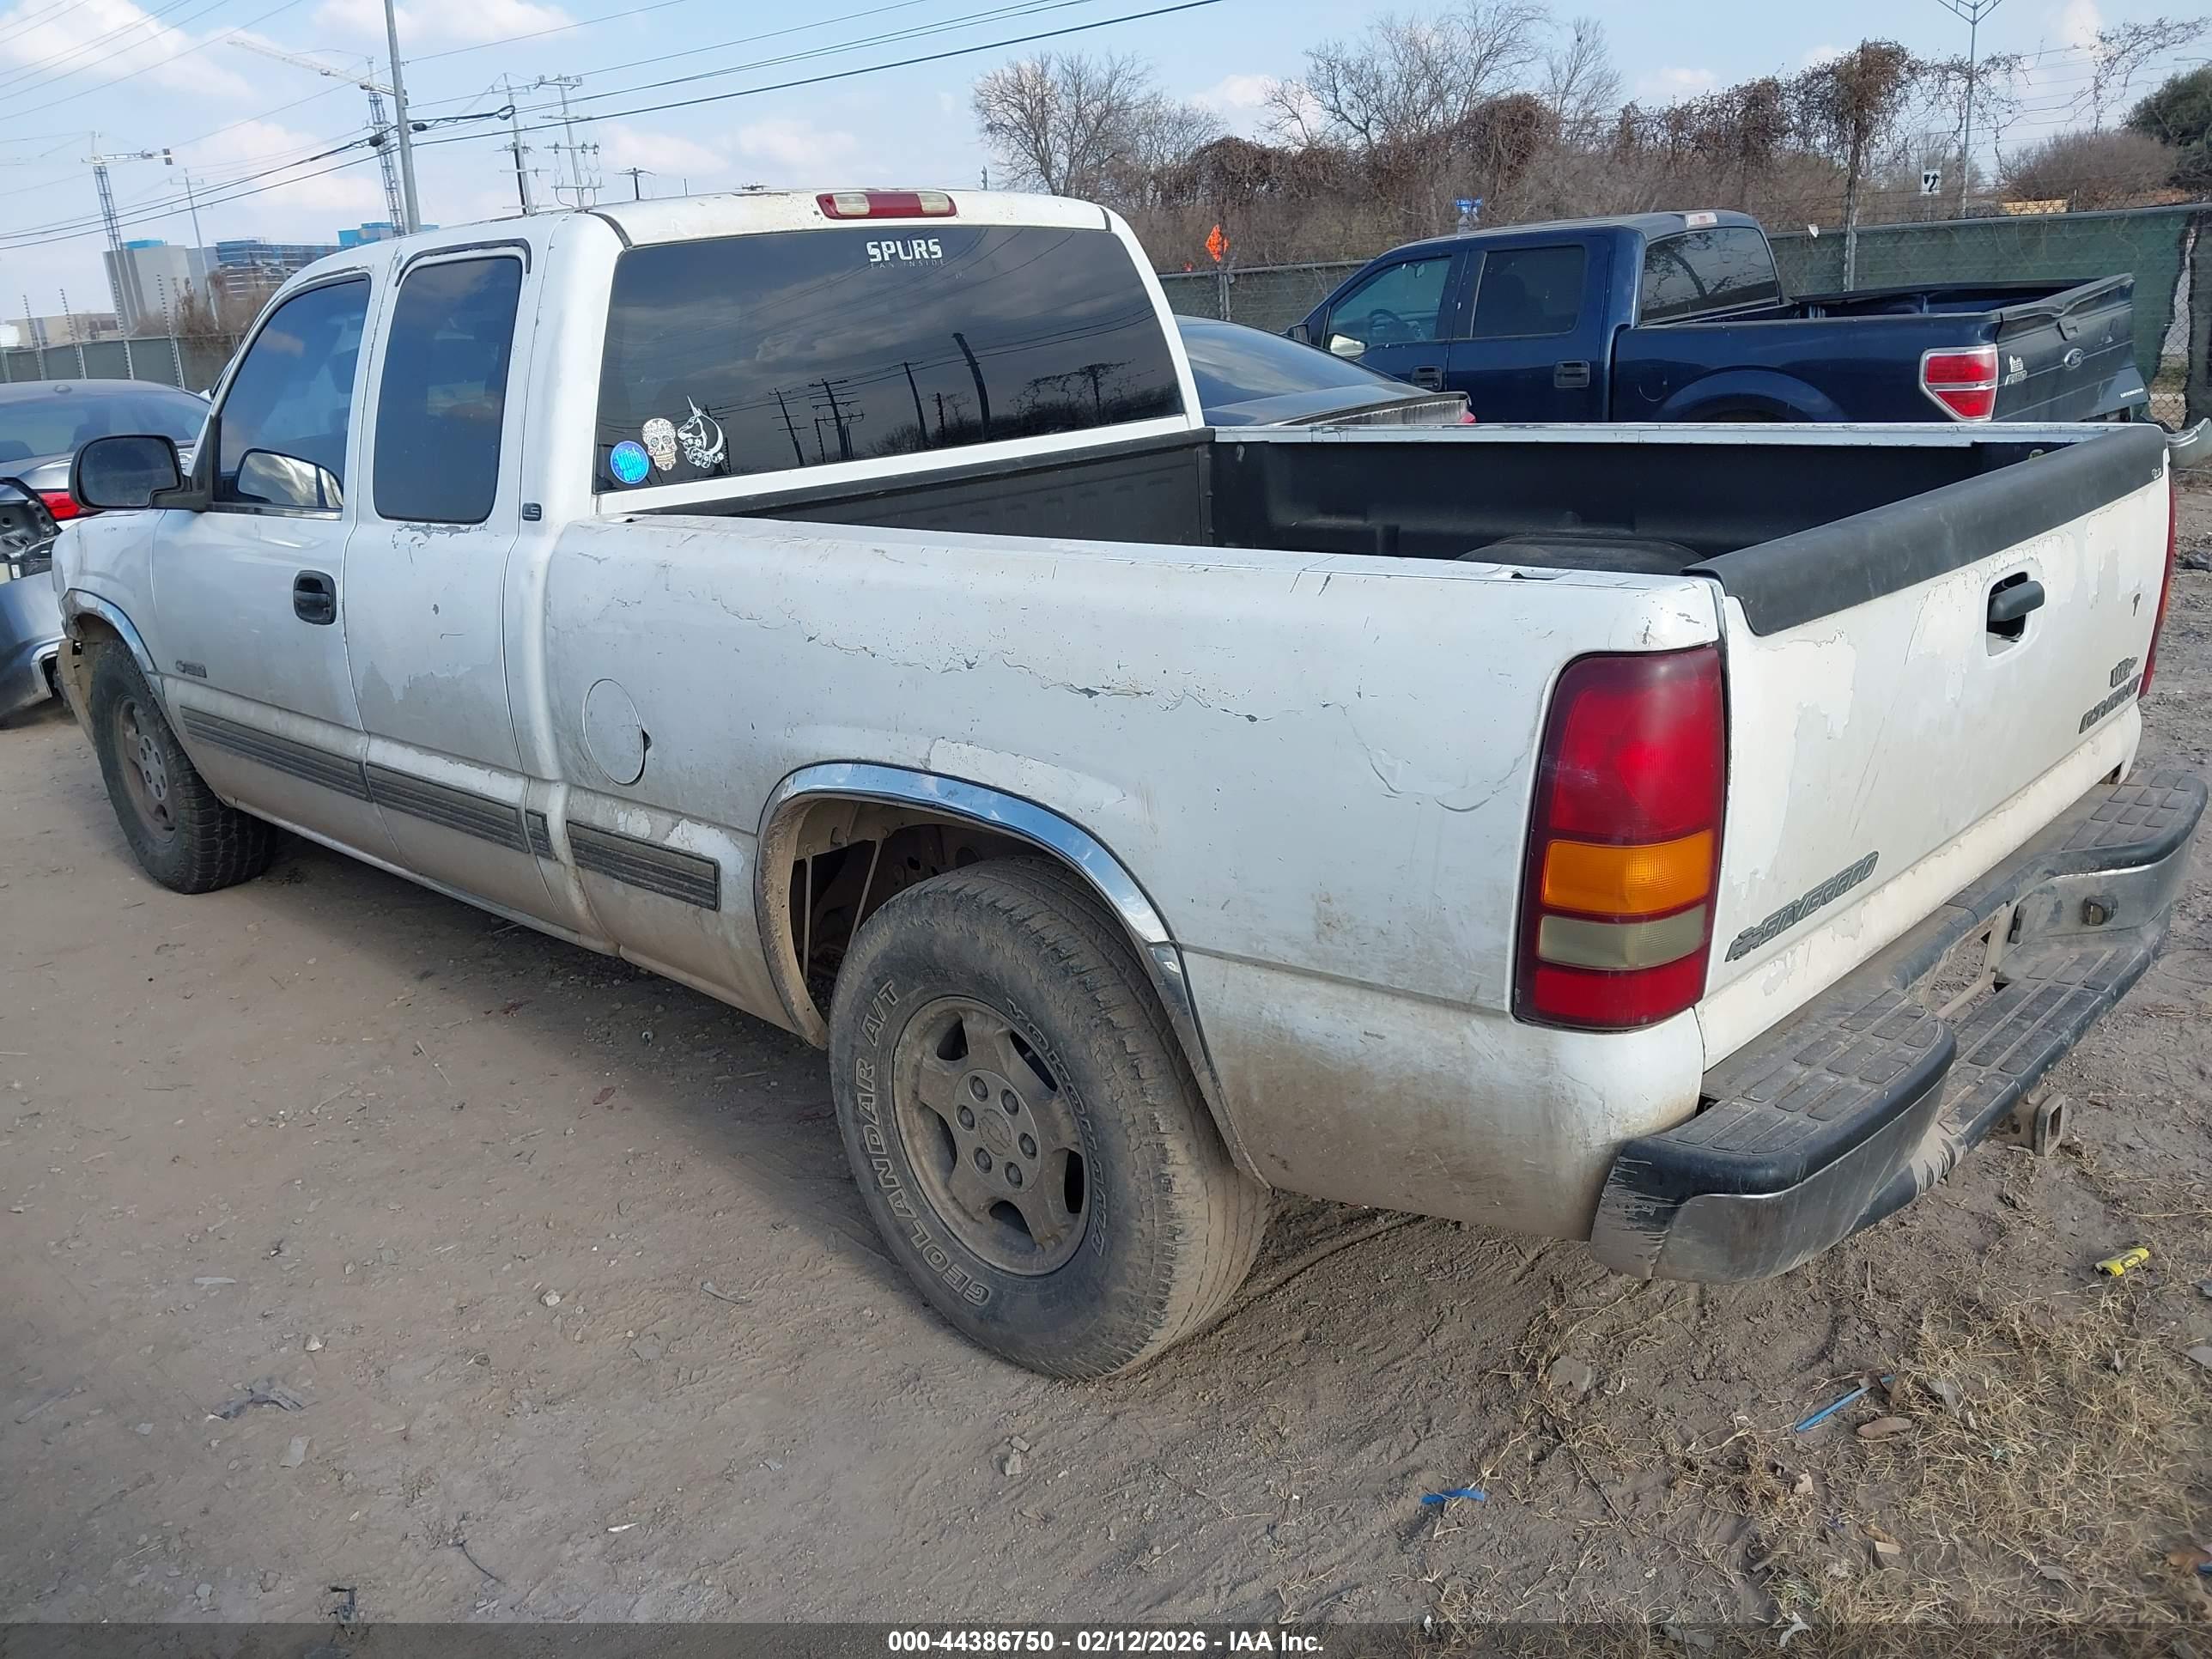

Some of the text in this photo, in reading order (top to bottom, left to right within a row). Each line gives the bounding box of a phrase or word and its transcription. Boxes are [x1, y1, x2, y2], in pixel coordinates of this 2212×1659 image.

[866, 238, 943, 263] SPURS
[903, 259, 946, 268] INSIDE
[523, 506, 540, 518] LS
[1758, 850, 1880, 946] SILVERADO
[860, 980, 900, 1047] A/T
[855, 1058, 993, 1306] GEOLANDAR
